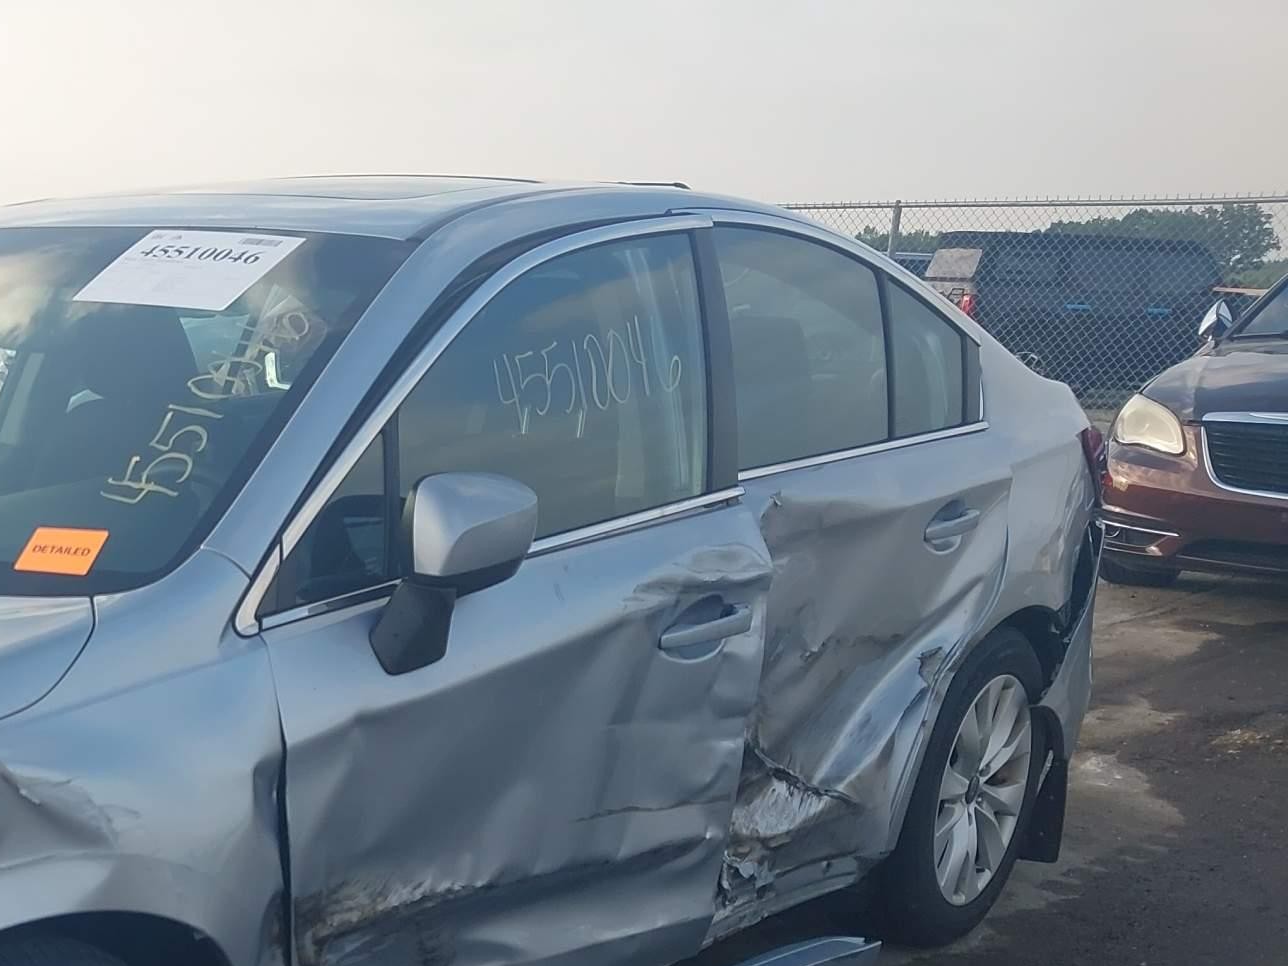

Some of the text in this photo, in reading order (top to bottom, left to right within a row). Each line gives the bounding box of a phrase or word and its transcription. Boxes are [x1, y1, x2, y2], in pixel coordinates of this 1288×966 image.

[141, 244, 264, 265] 45510046
[493, 315, 682, 436] 45510046
[32, 545, 92, 556] DETAILED
